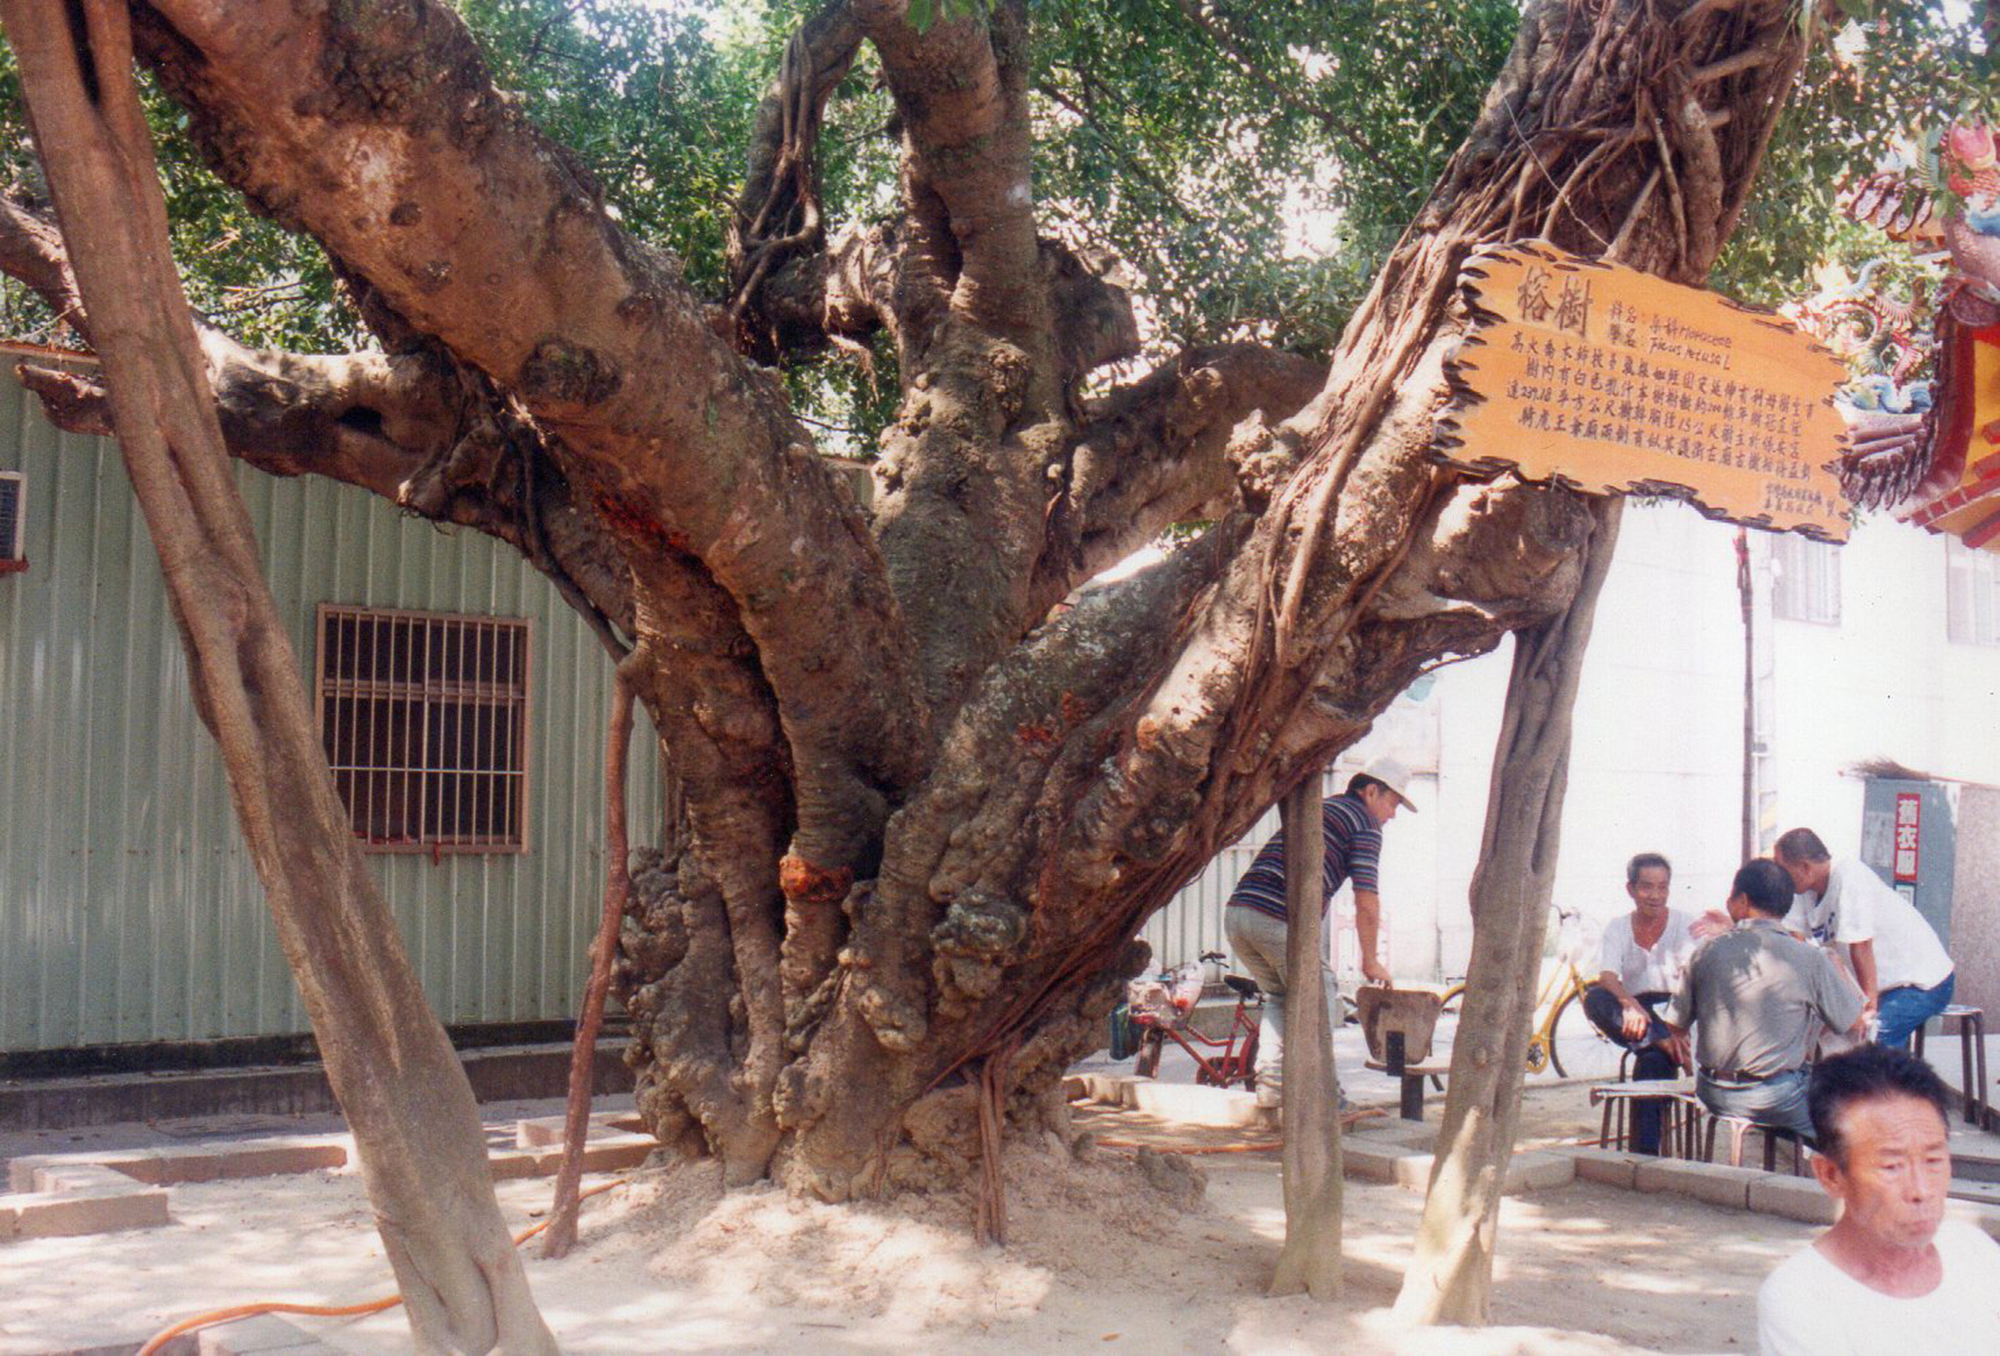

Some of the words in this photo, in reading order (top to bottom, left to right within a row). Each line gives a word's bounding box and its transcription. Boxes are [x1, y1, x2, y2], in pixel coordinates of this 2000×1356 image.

[1517, 265, 1593, 337] 榕樹
[1895, 798, 1918, 876] 舊衣服
